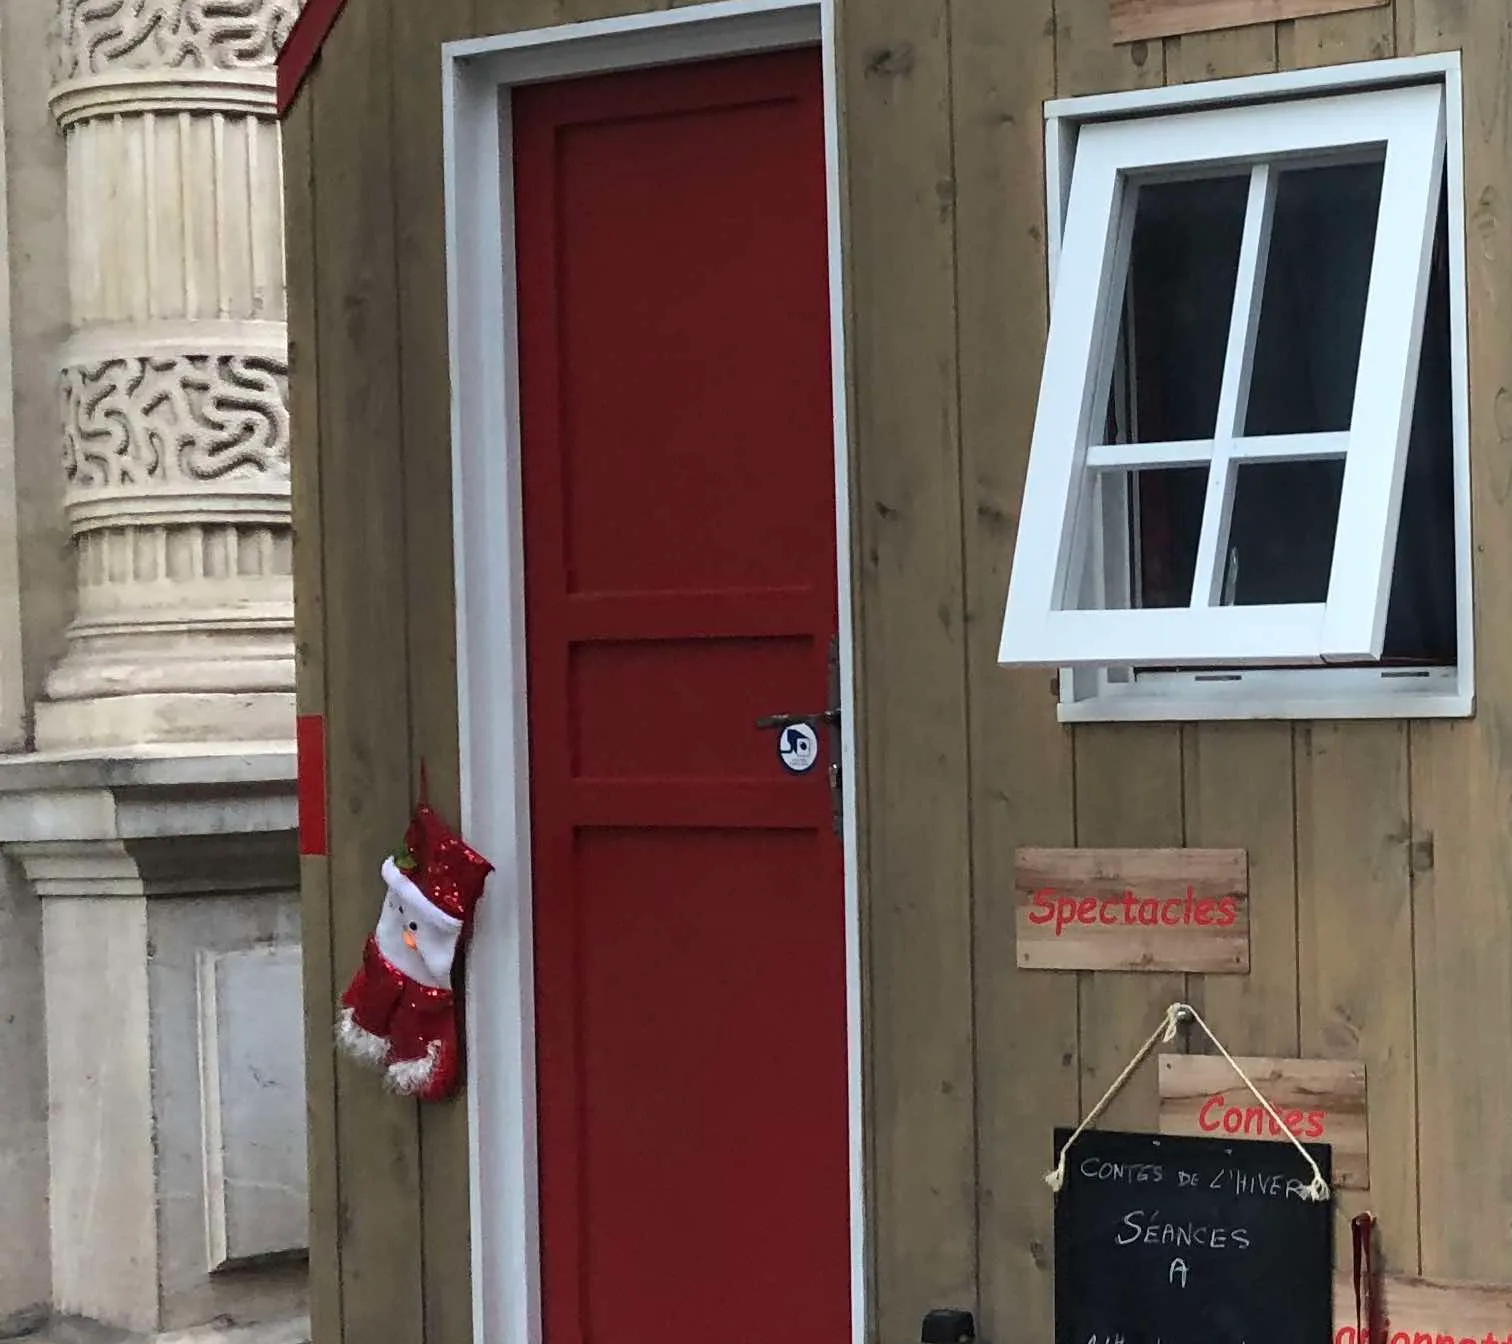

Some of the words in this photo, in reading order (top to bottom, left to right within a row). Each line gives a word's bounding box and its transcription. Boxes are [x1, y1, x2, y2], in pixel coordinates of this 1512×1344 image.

[1028, 885, 1238, 937] Spectacles
[1199, 1095, 1327, 1138] Contes
[1080, 1158, 1163, 1185] CONTES
[1177, 1170, 1199, 1187] DE
[1115, 1209, 1250, 1250] SÉANCES
[1169, 1257, 1189, 1288] A
